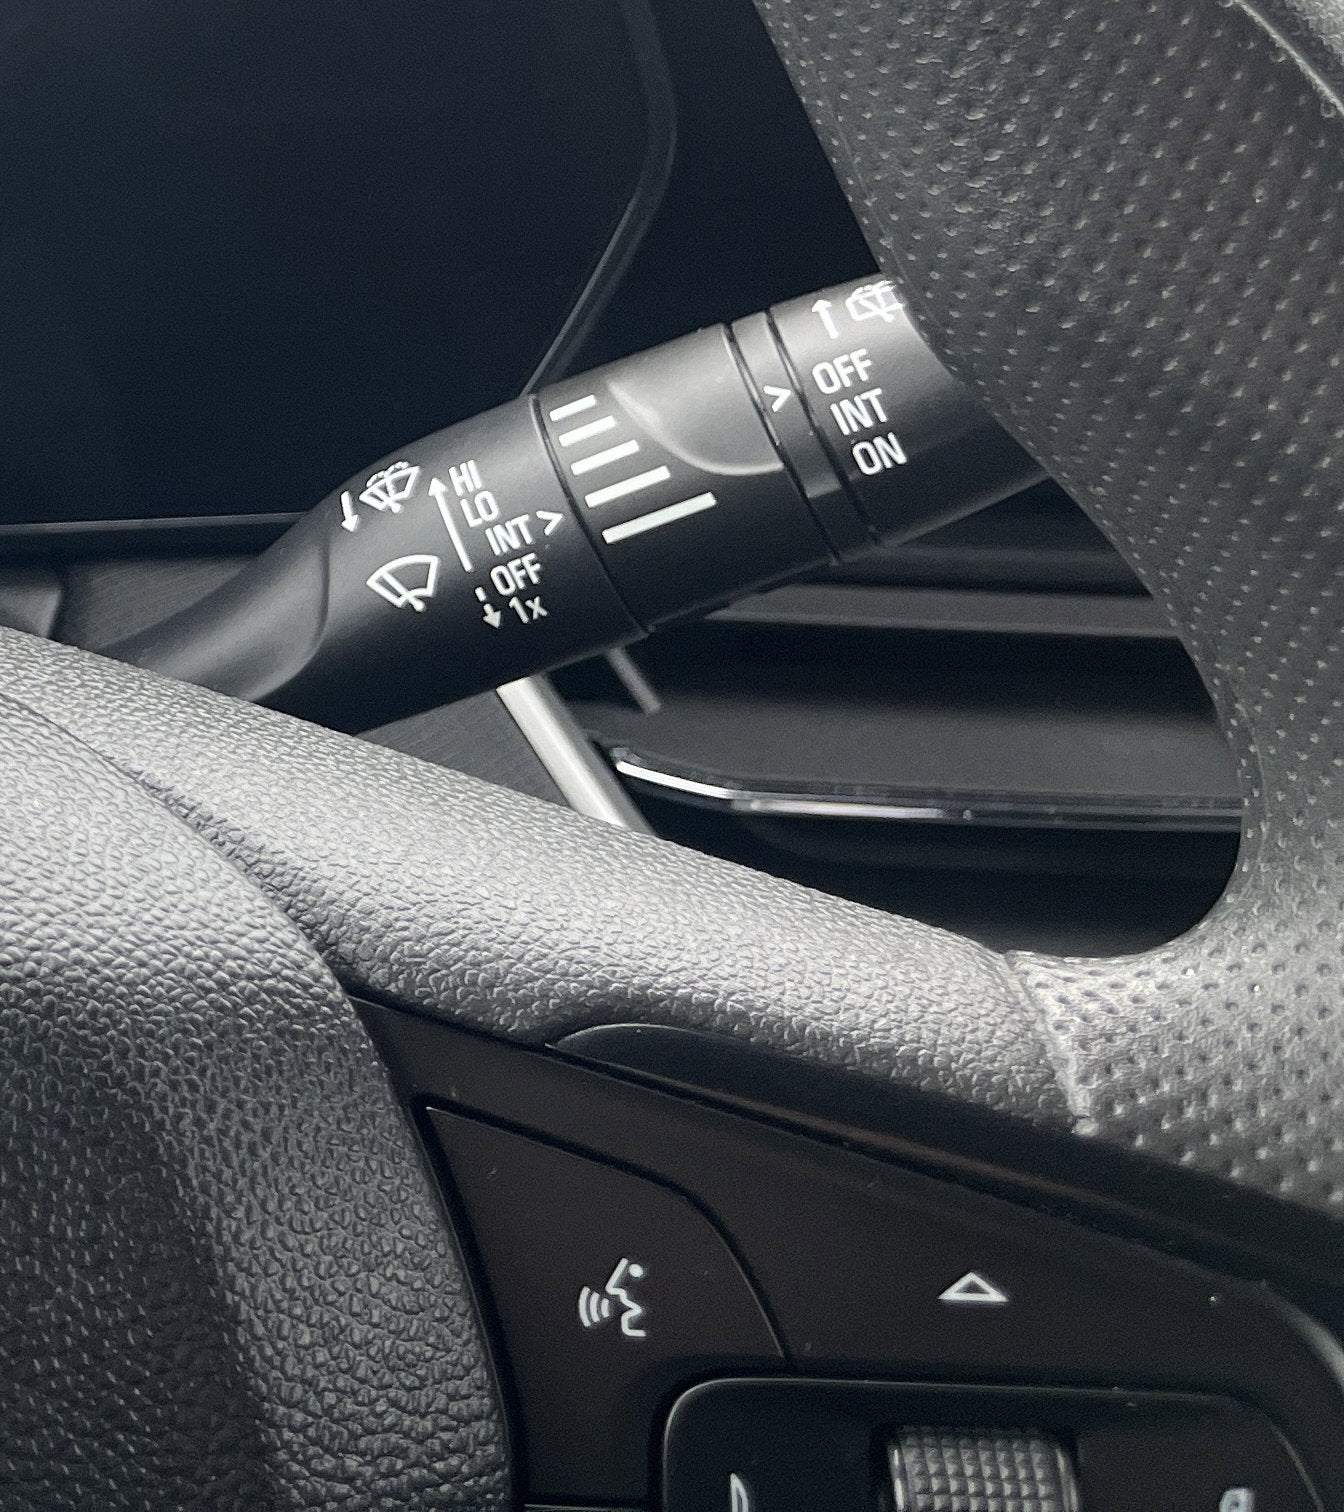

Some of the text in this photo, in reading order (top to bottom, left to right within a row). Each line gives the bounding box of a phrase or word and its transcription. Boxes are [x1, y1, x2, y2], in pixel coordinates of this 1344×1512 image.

[812, 348, 872, 395] OFF
[829, 387, 888, 436] INT
[851, 431, 908, 476] ON
[448, 459, 483, 497] HI
[459, 490, 500, 528] LO
[484, 513, 534, 557] INT
[489, 552, 542, 597] OFF
[508, 595, 549, 625] 1x
